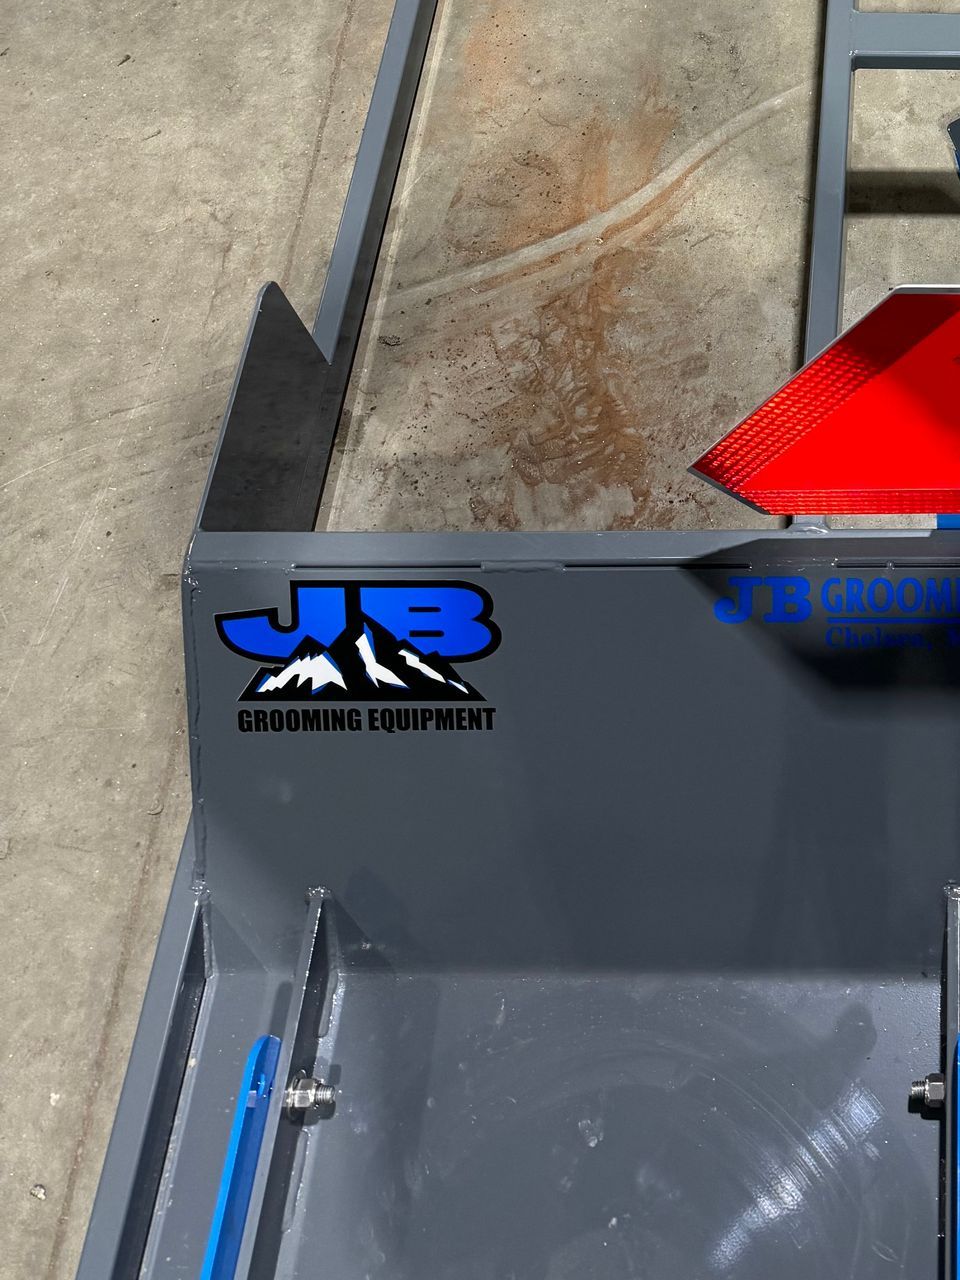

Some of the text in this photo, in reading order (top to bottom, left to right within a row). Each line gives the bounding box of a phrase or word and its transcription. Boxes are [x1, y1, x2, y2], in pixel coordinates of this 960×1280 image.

[214, 580, 502, 663] JB
[714, 576, 812, 624] JB
[238, 707, 497, 733] GROOMING EQUIPMENT
